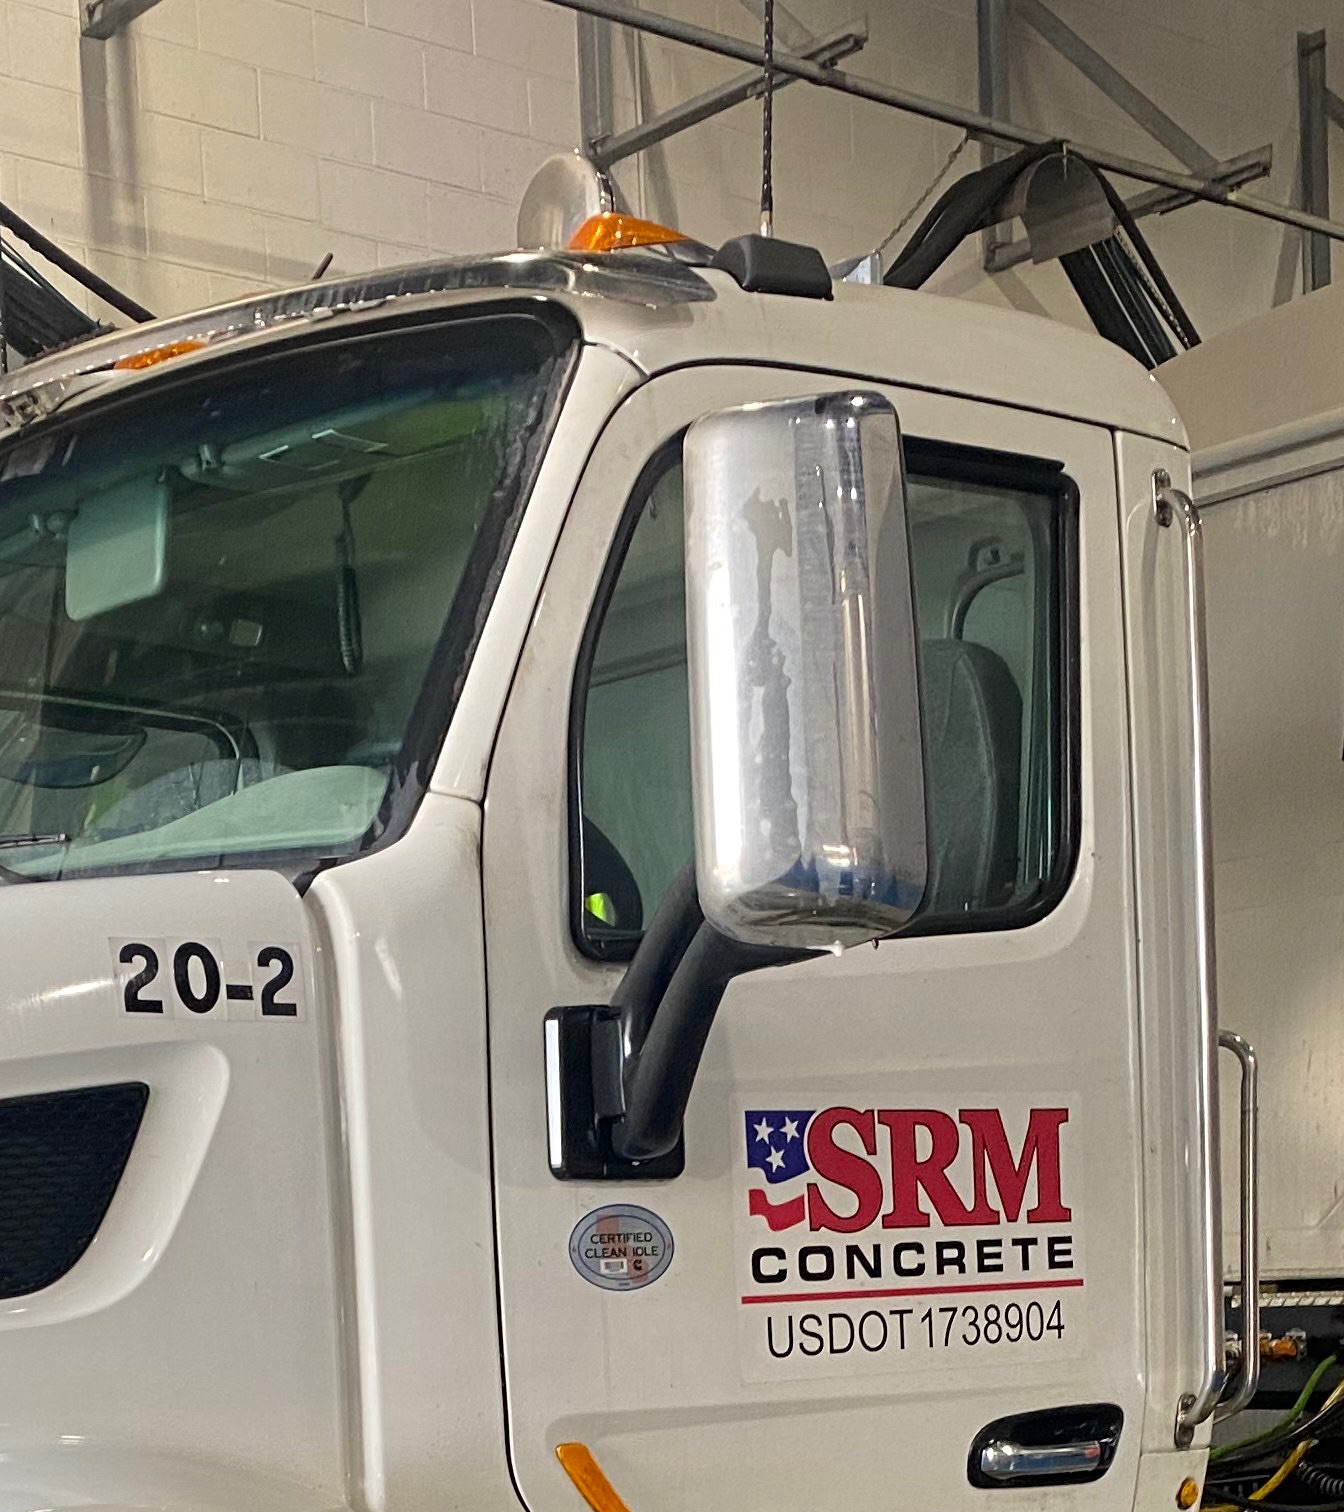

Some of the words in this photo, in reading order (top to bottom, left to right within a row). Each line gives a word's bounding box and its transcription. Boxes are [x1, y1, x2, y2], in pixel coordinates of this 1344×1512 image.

[119, 942, 298, 1017] 20-2
[807, 1106, 1072, 1234] SRM
[585, 1246, 627, 1259] CLEAN
[632, 1245, 659, 1257] IDLE
[590, 1232, 653, 1245] CERTIFIED
[751, 1236, 1074, 1284] CONCRETE
[767, 1308, 914, 1359] USDOT
[921, 1300, 1065, 1348] 1738904
